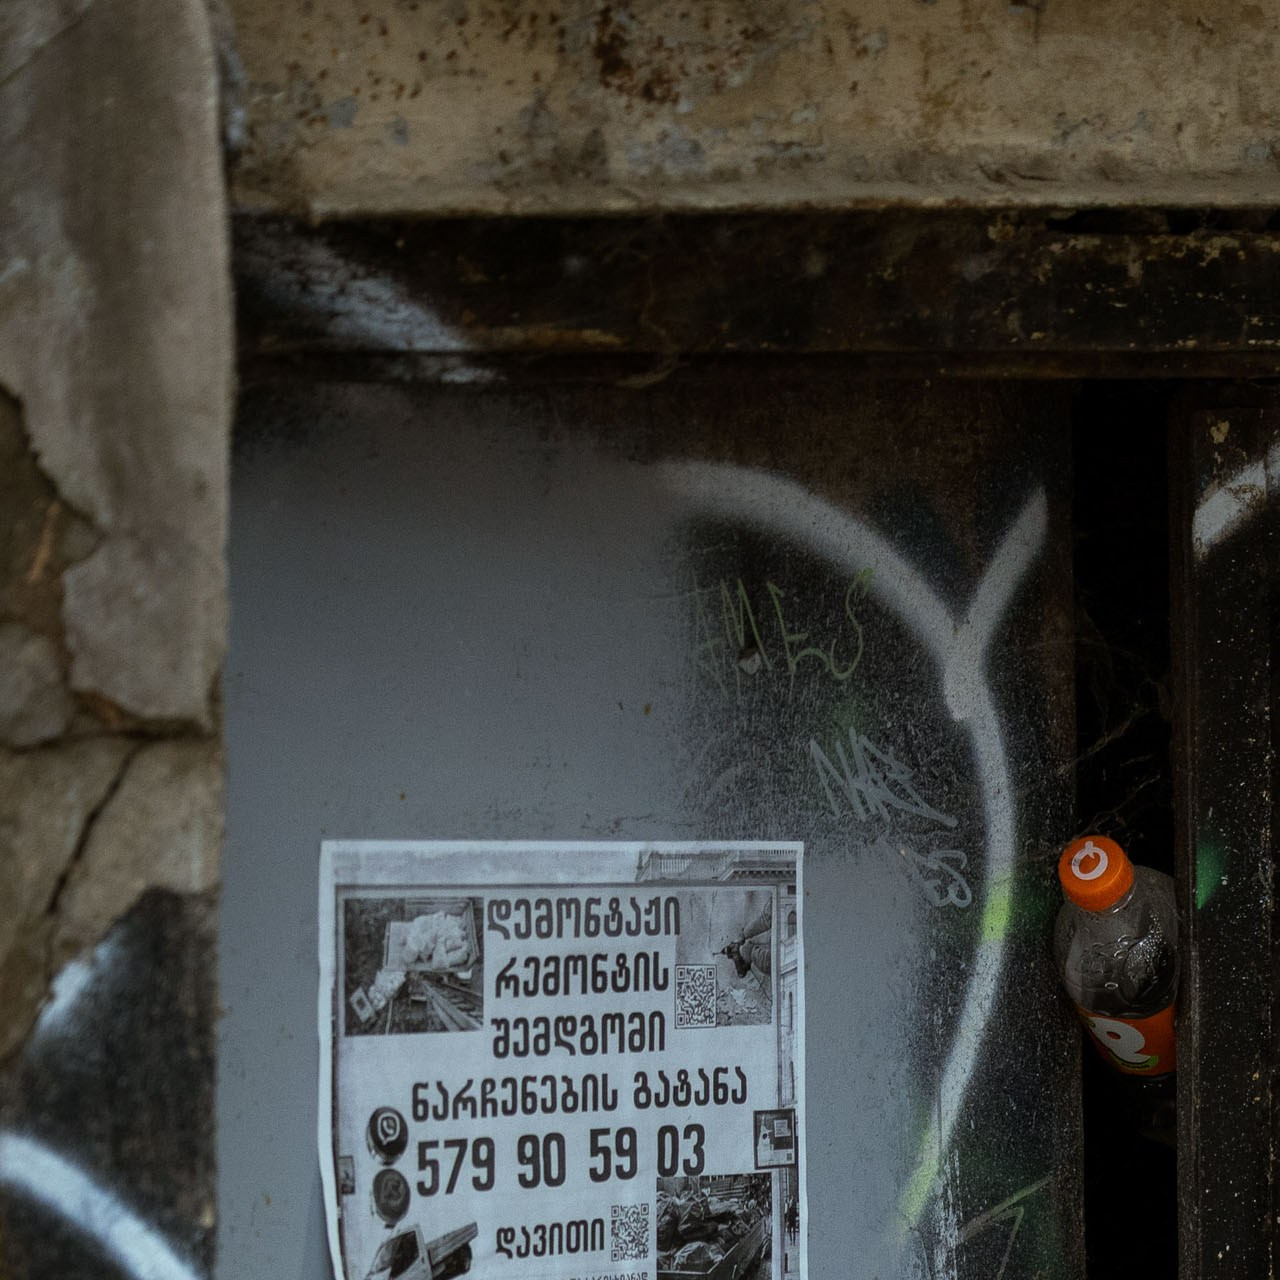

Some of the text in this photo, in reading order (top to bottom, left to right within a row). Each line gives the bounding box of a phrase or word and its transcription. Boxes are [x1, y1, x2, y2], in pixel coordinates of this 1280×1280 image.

[487, 896, 681, 941] დემონტაჟი
[495, 951, 670, 999] რემონტის
[493, 1010, 666, 1058] შემდგომი
[411, 1066, 748, 1123] ნარჩენების გატანა
[416, 1123, 706, 1197] 579 90 59 03
[495, 1218, 605, 1259] დავითი
